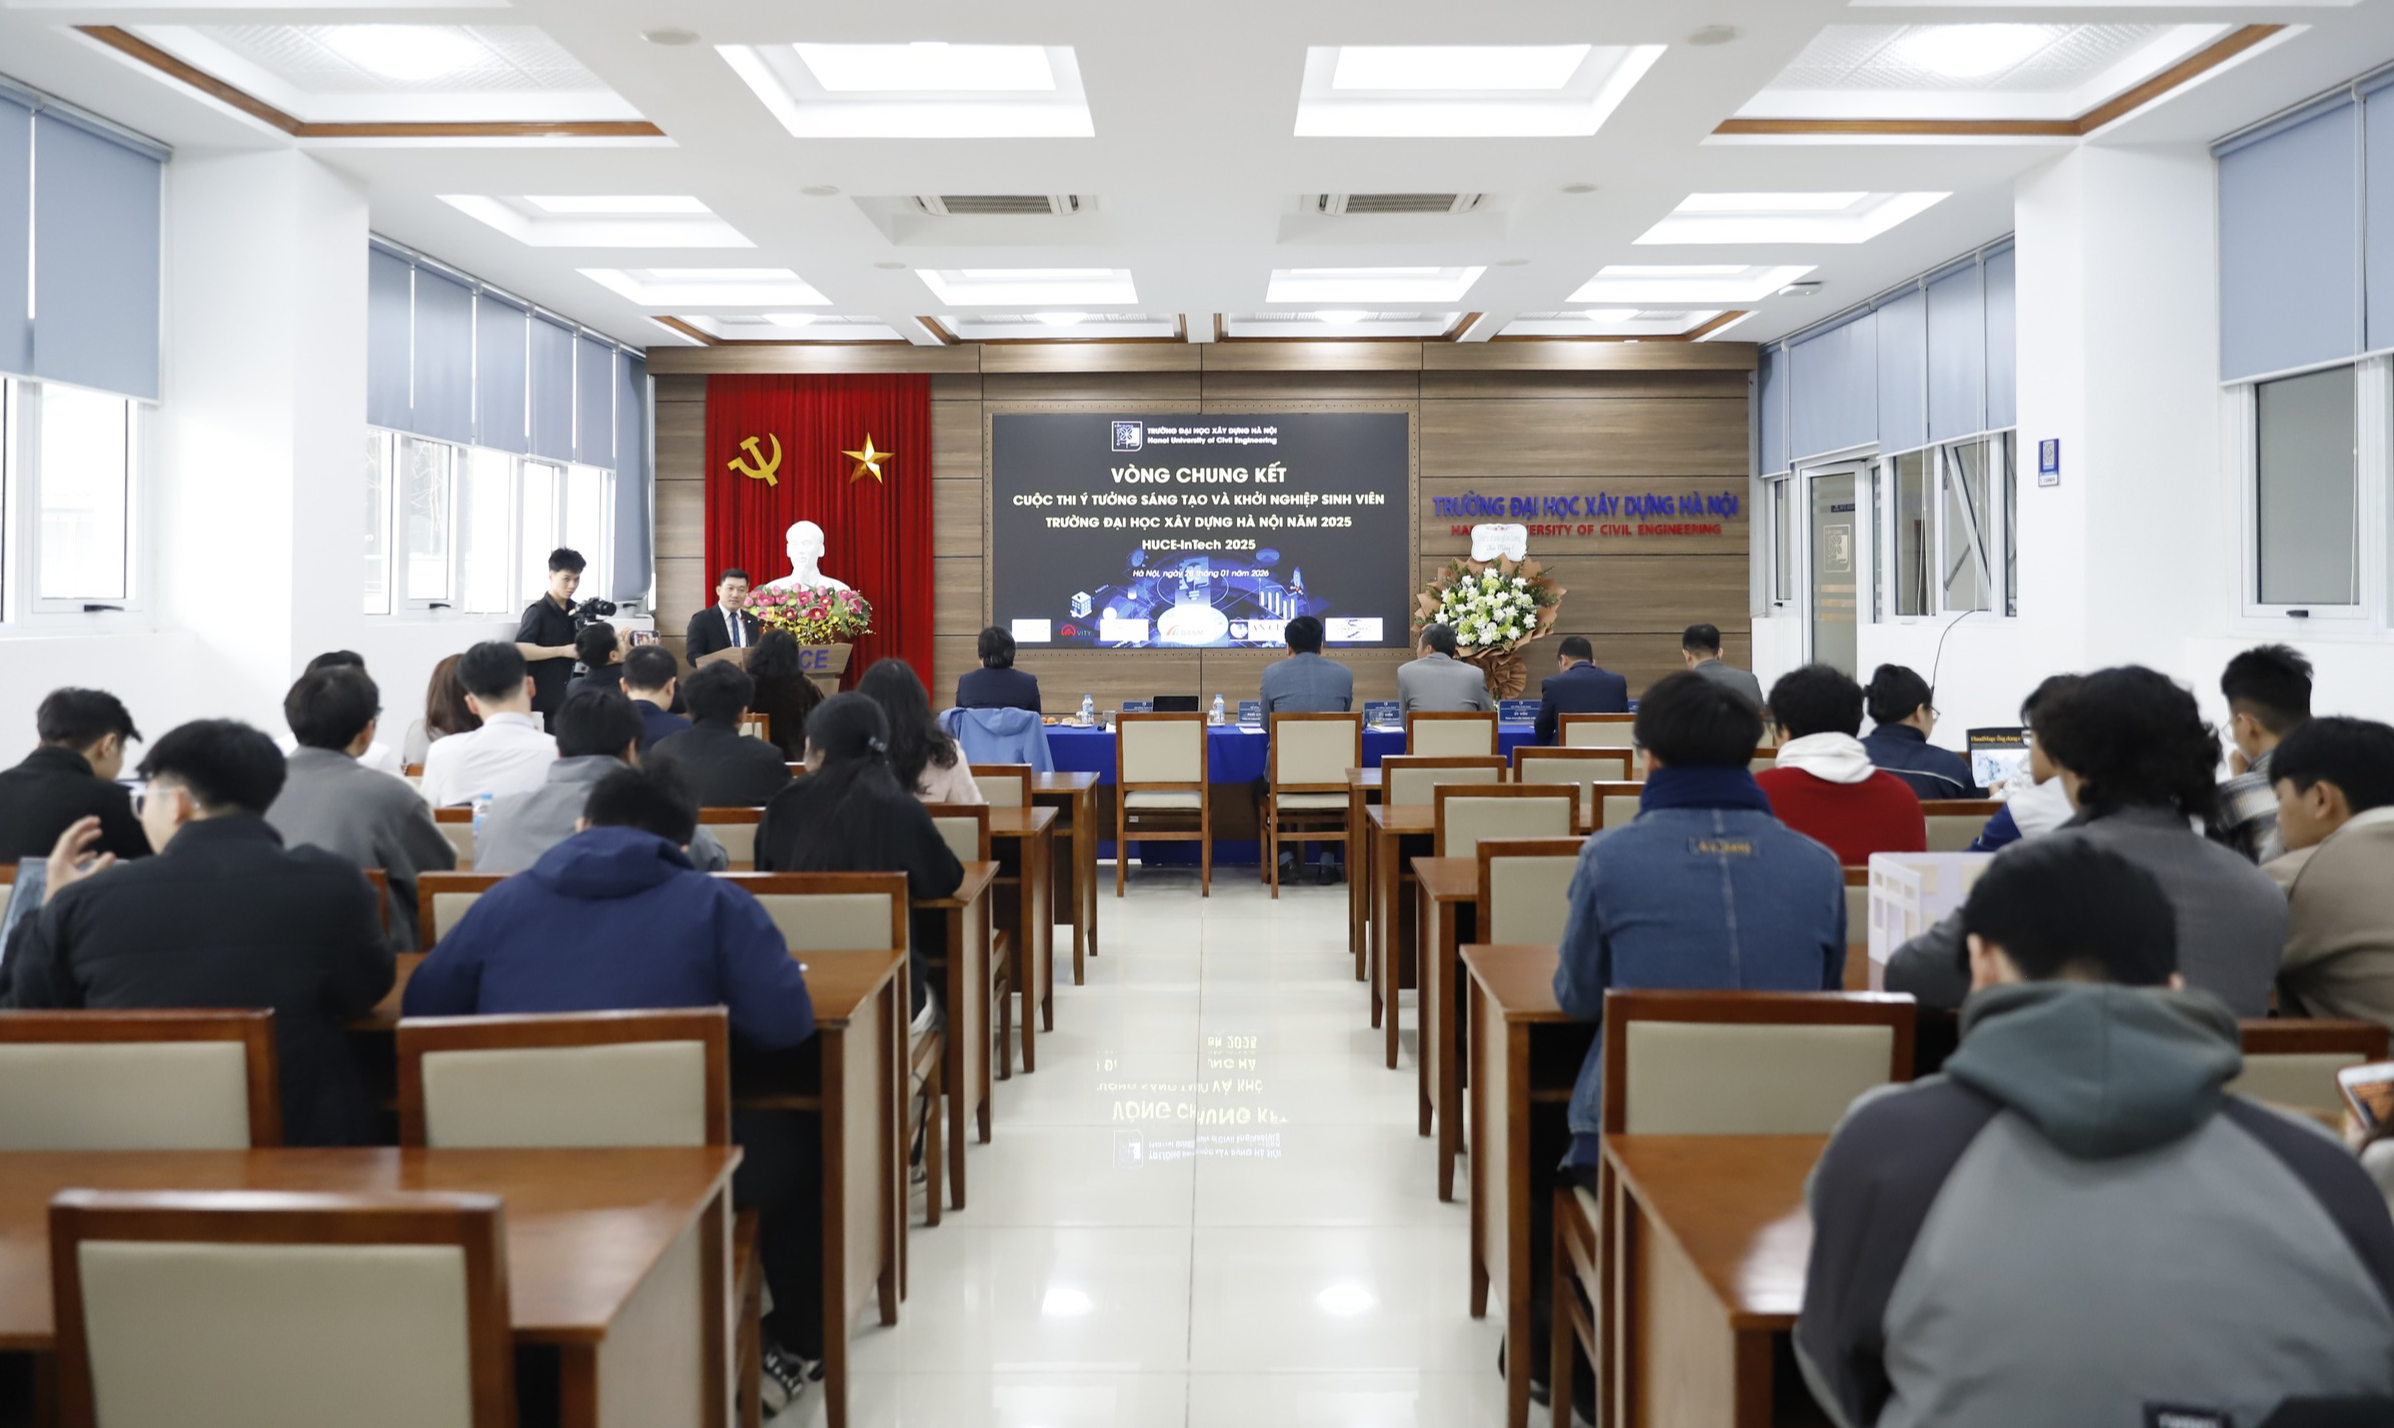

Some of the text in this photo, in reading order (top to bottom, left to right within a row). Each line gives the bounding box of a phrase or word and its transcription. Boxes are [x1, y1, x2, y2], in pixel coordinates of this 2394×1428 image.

[1170, 437, 1206, 445] University
[1234, 437, 1278, 446] Engineering
[1110, 460, 1288, 484] VÒNG CHUNG KẾT
[1013, 491, 1385, 509] CUỘC THI Ý TƯỞNG SÁNG TẠO VÀ KHỞI NGHIỆP SINH VIÊN
[1433, 490, 1738, 520] TRƯỜNG ĐẠI HỌC XÂY DỰNG HÀ NỘI
[1045, 513, 1352, 531] TRƯỜNG ĐẠI HỌC XÂY DỰNG HÀ NỘI NĂM 2025
[1527, 524, 1572, 536] ERSITY
[1577, 524, 1594, 535] OF
[1600, 524, 1632, 536] CIVIL
[1637, 524, 1721, 535] ENGINEERING
[1142, 539, 1257, 550] HUCE-InTech 2025
[1132, 569, 1144, 577] Hà
[1163, 570, 1182, 579] ngày
[1220, 569, 1229, 577] 01
[1231, 569, 1250, 577] năm
[1251, 569, 1269, 577] 2026
[799, 649, 829, 669] CE
